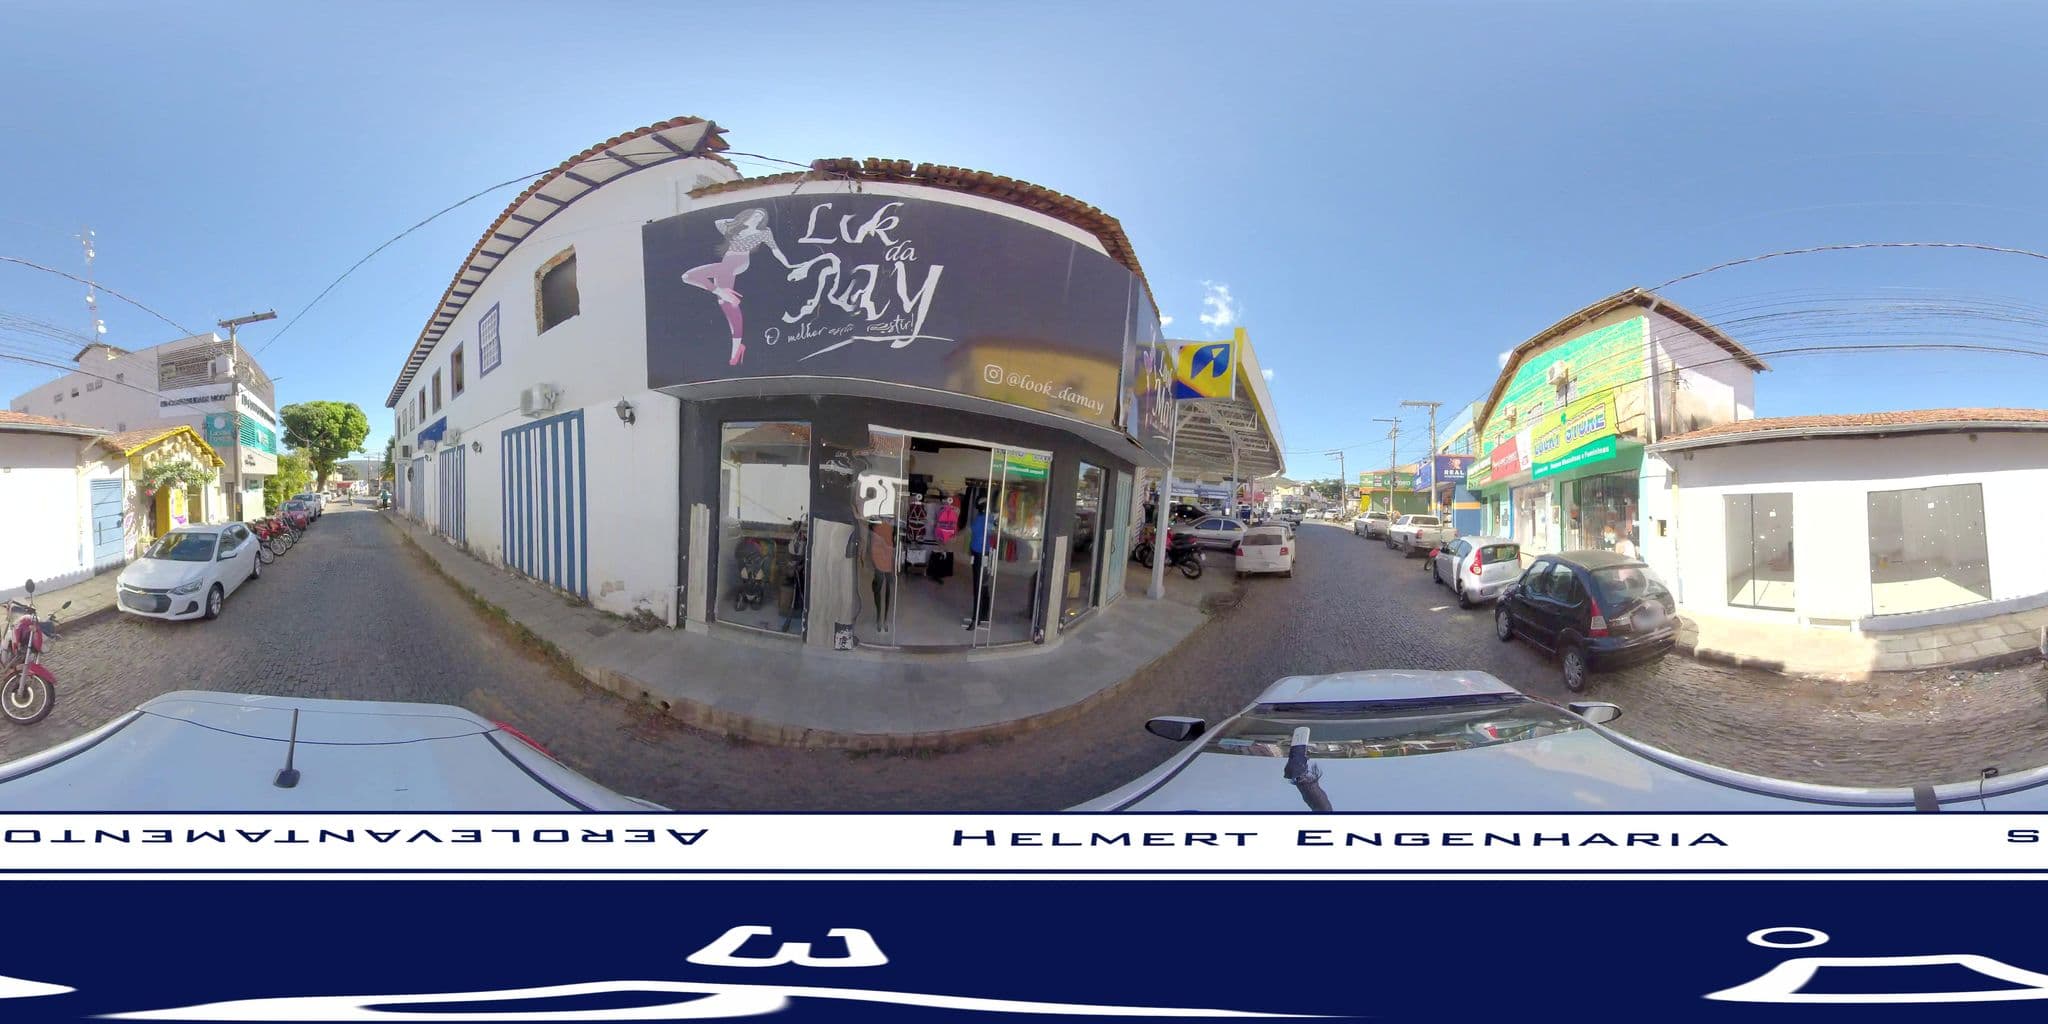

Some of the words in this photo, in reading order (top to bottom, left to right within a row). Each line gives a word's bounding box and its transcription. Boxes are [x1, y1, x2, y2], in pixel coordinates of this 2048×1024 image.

[885, 239, 918, 262] da
[764, 327, 780, 346] O
[1006, 372, 1104, 415] @look_damay
